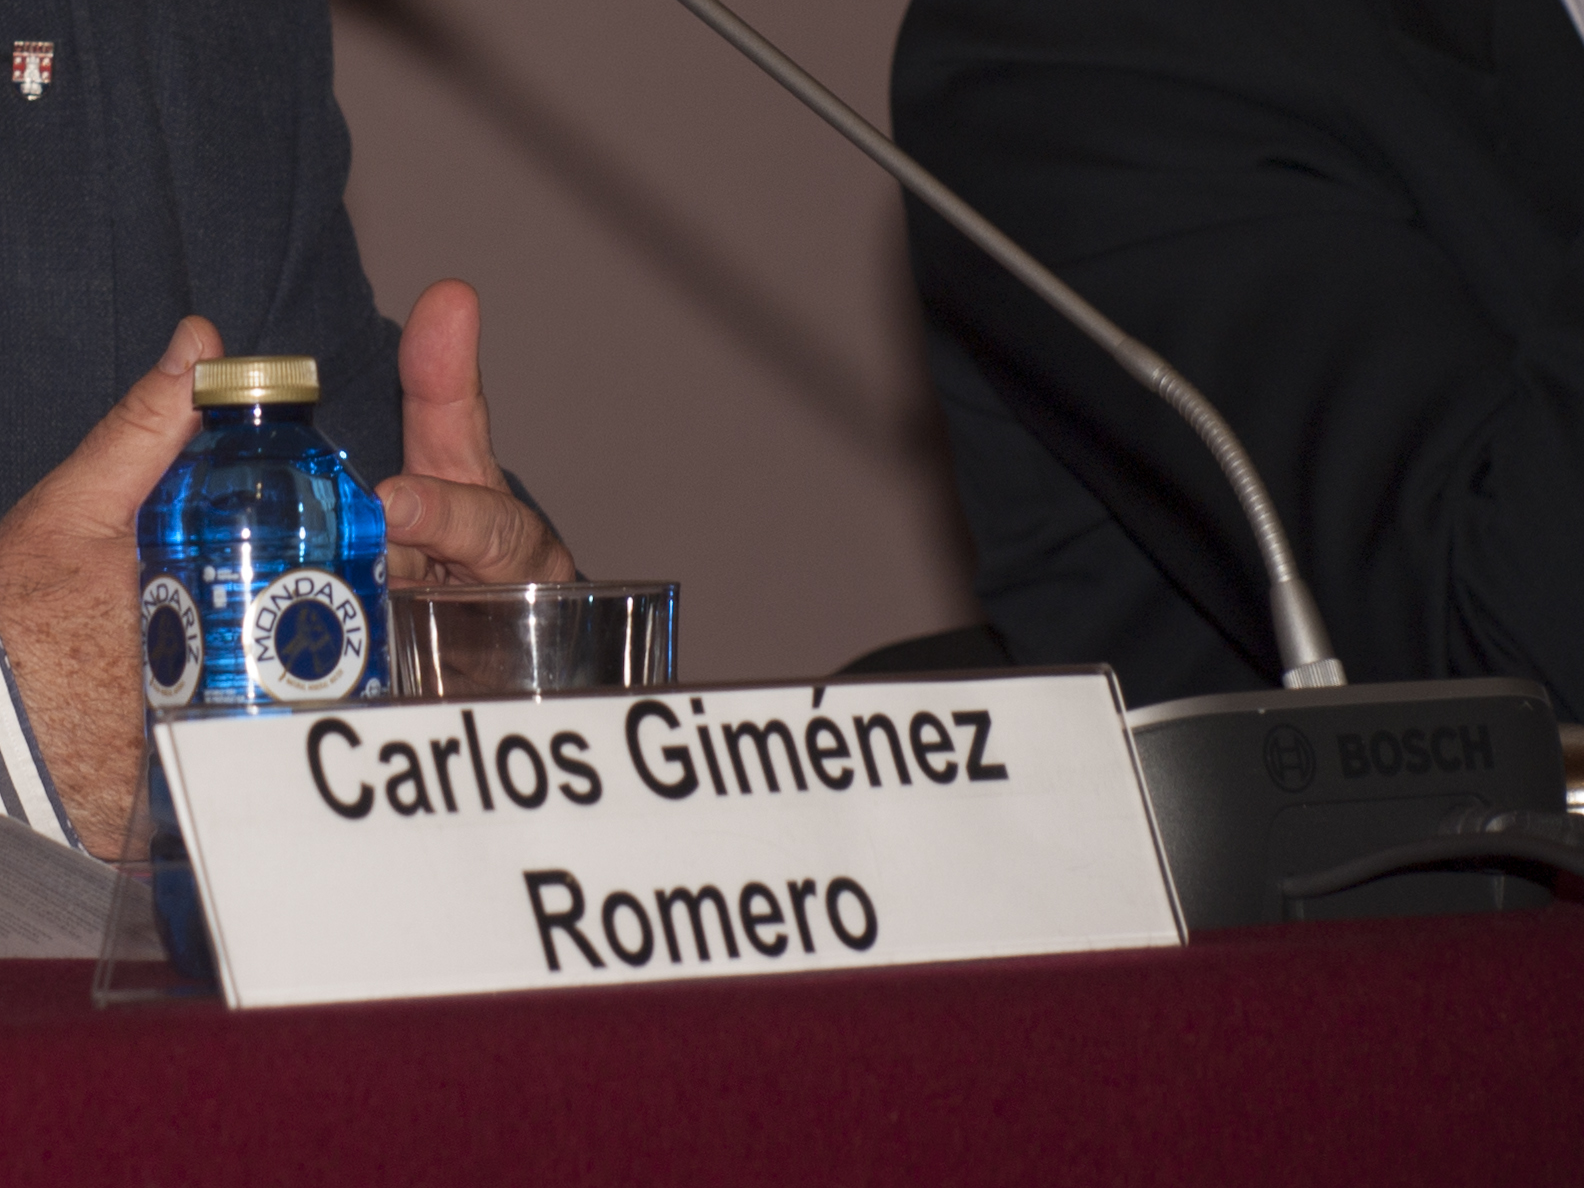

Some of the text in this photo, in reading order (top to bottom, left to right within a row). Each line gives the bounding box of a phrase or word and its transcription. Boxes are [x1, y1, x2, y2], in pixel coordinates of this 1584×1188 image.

[142, 582, 200, 665] NDARIZ
[254, 577, 363, 662] MONDARIZ
[305, 685, 1009, 820] Carlos Giménez
[1336, 724, 1495, 780] BOSCH
[522, 868, 879, 972] Romero
